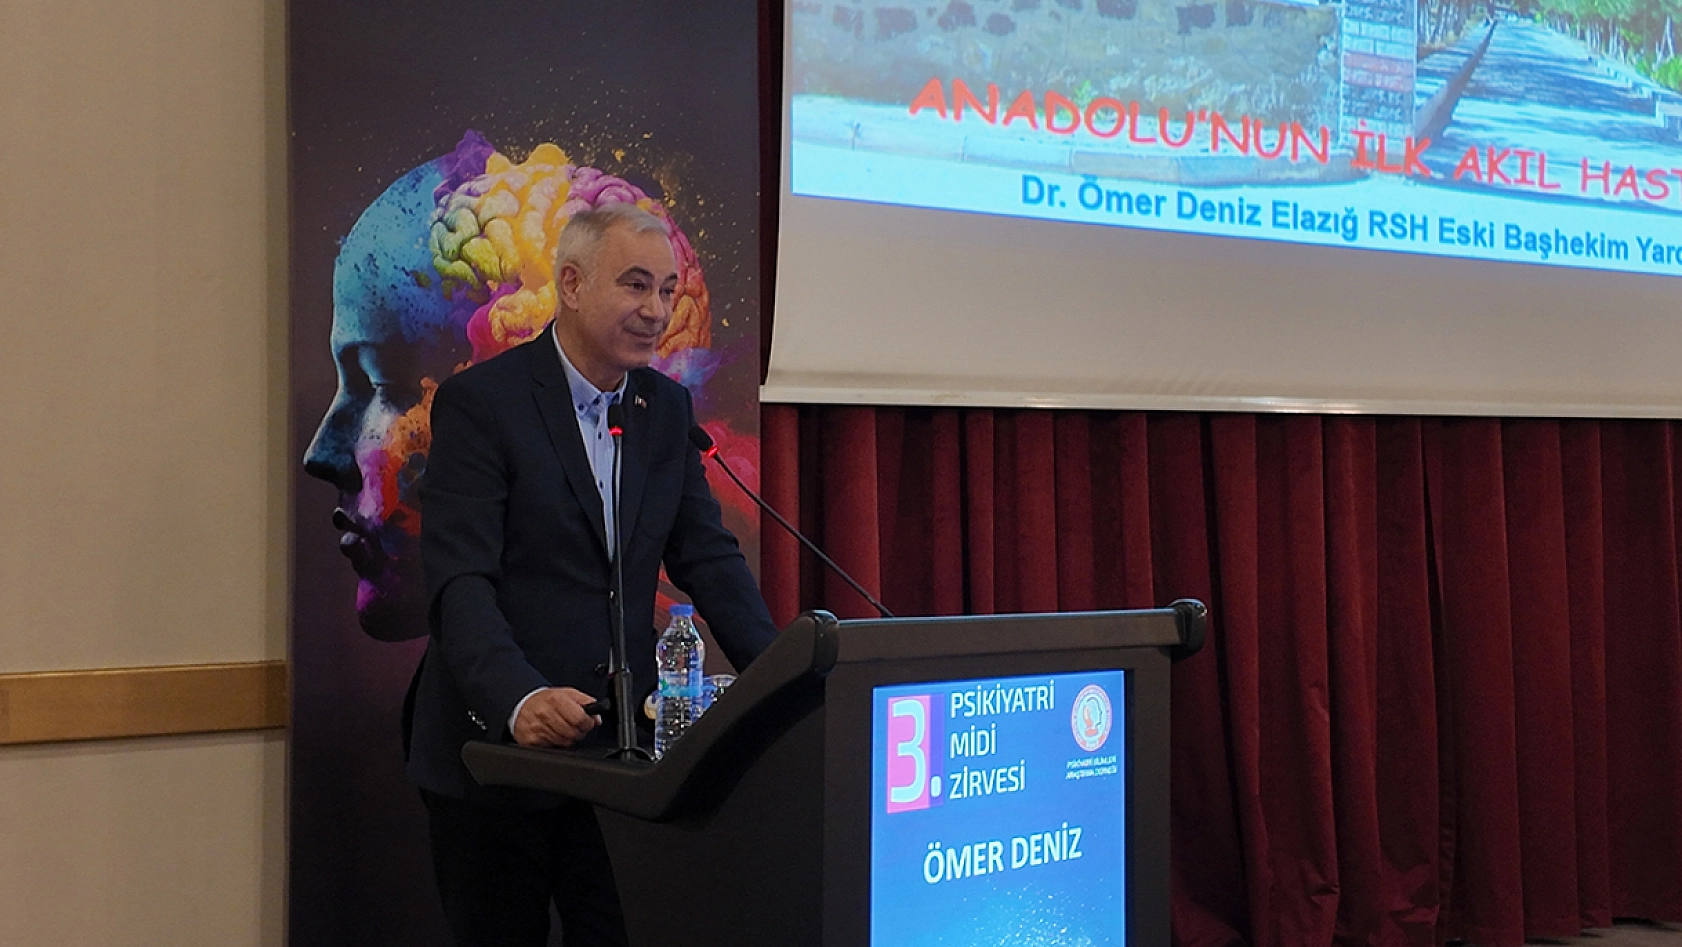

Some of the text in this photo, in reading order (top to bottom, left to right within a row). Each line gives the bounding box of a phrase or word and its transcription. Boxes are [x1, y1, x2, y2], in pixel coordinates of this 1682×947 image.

[909, 76, 1330, 165] ANADOLU'NUN
[1350, 119, 1432, 178] İLK
[1453, 145, 1561, 190] AKIL
[1021, 173, 1066, 208] Dr.
[1078, 173, 1168, 218] Ömer
[1176, 190, 1262, 226] Deniz
[1271, 200, 1358, 242] Elazığ
[1369, 209, 1429, 243] RSH
[1439, 217, 1495, 249] Eski
[1504, 222, 1629, 261] Başhekim
[950, 679, 1055, 719] PSİKİYATRİ
[890, 698, 942, 803] 3.
[950, 723, 997, 759] MİDİ
[949, 759, 1026, 799] ZİRVESİ
[923, 821, 1083, 884] ÖMER DENİZ
